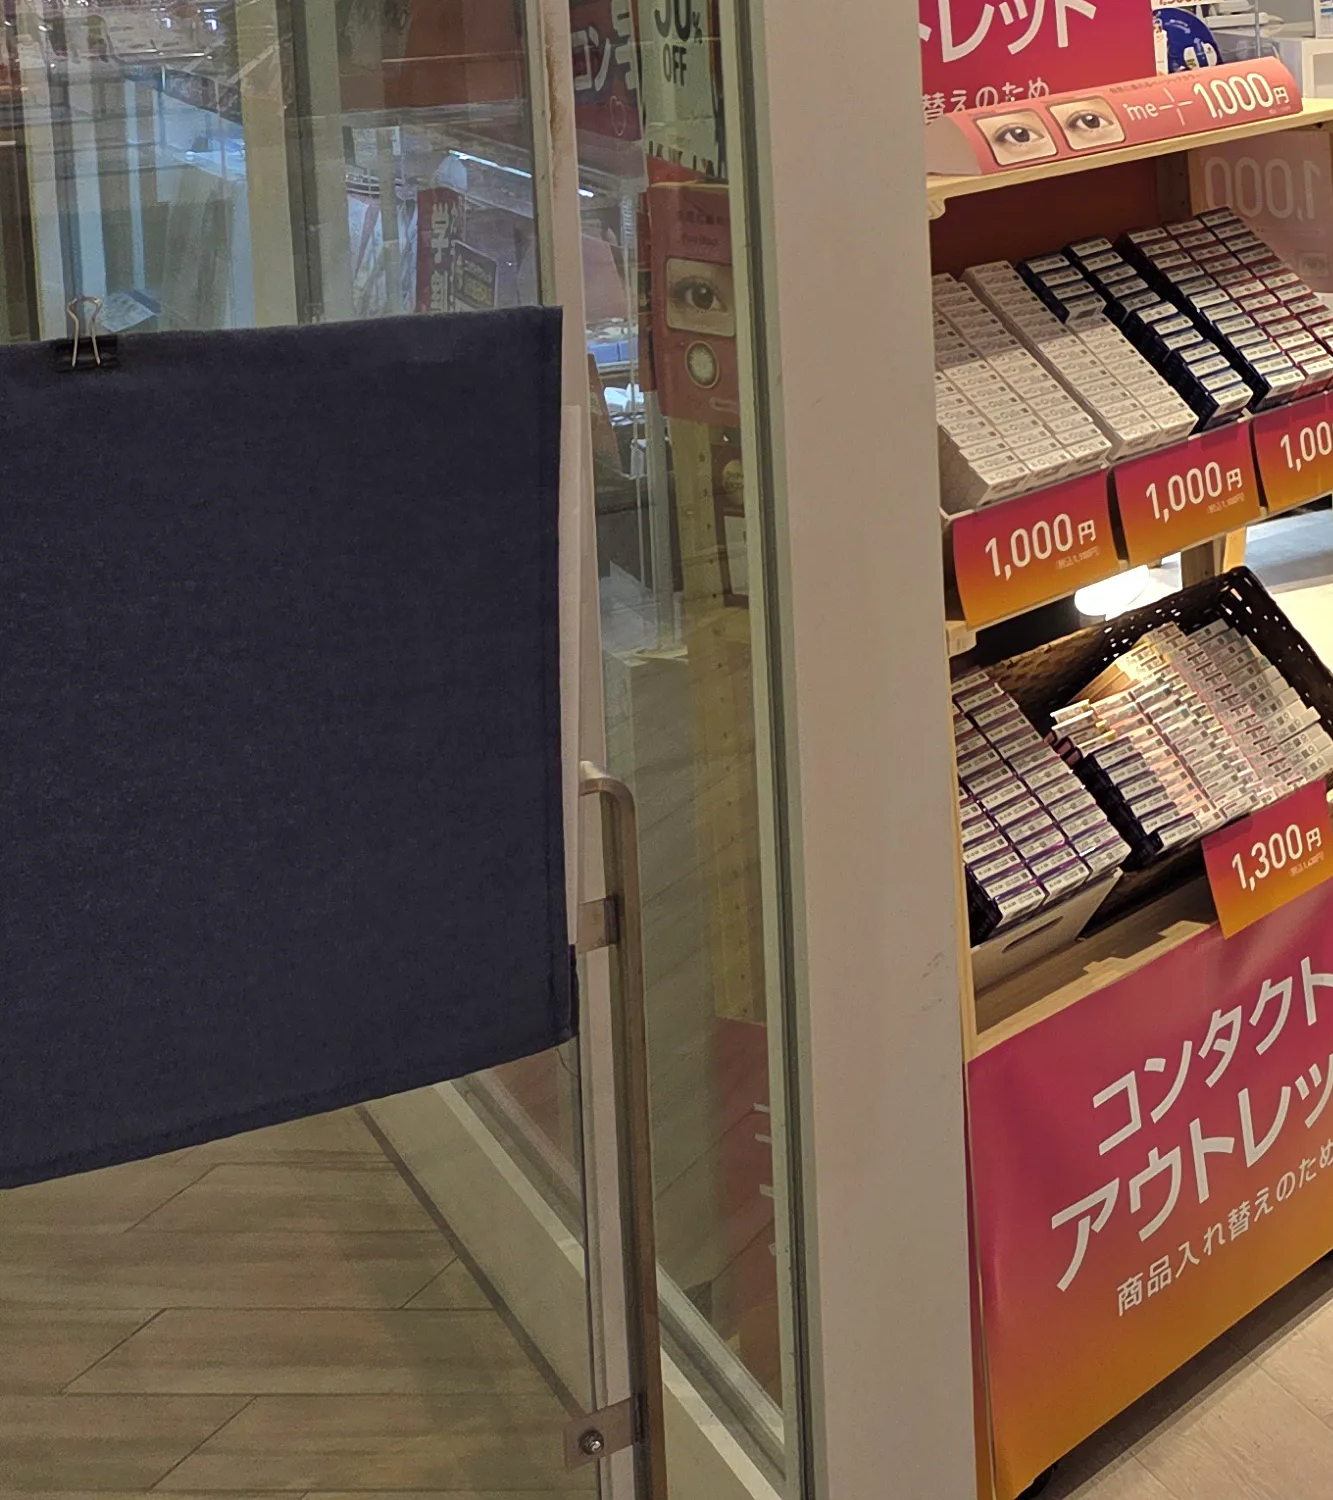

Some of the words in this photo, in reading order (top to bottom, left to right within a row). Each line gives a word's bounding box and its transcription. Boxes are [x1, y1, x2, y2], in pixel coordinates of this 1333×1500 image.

[1145, 461, 1244, 523] 1,000円
[984, 513, 1097, 581] 1,000円
[1230, 822, 1322, 892] 1,300円
